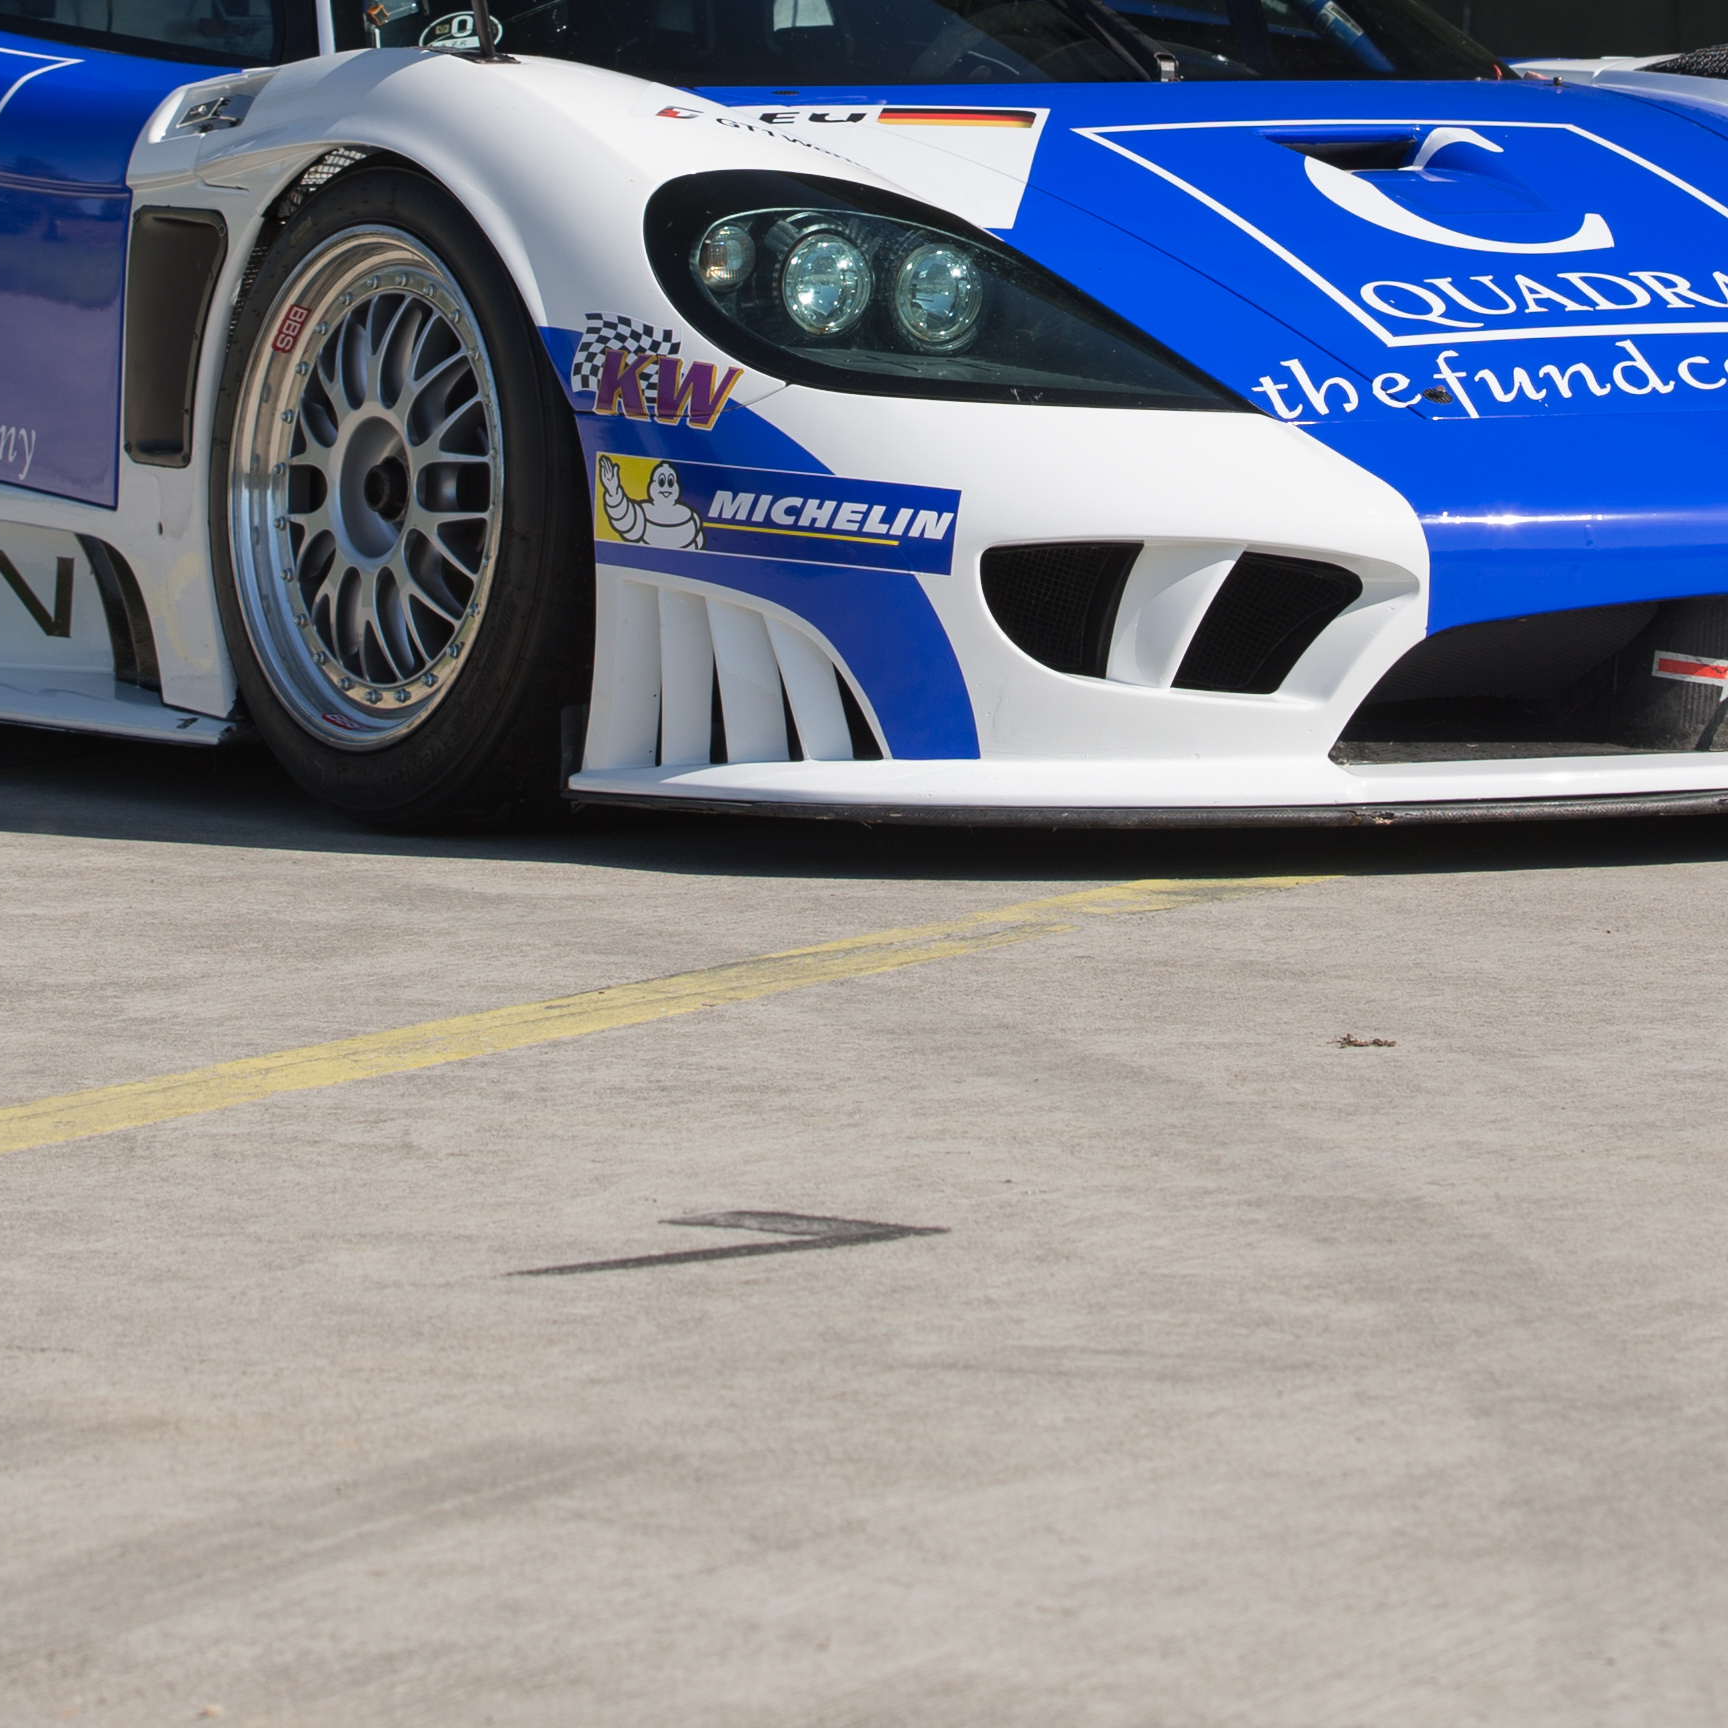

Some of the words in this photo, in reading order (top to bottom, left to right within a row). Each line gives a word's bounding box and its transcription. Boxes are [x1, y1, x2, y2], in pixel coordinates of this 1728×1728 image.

[274, 305, 310, 352] BBS
[591, 346, 744, 431] KW
[706, 489, 955, 541] MICHELIN
